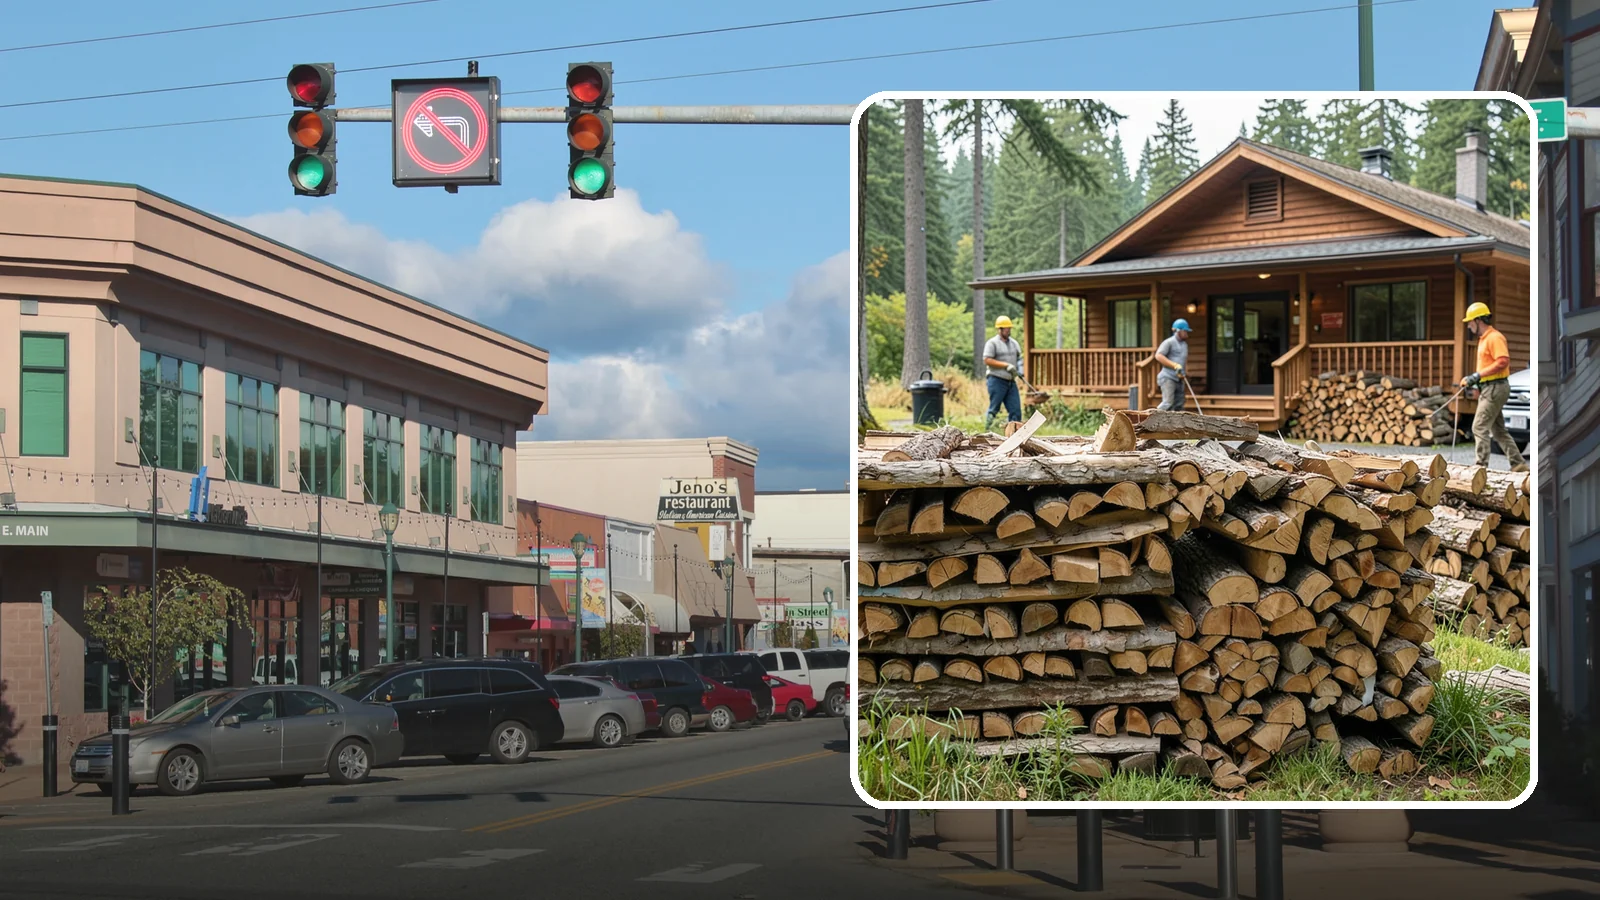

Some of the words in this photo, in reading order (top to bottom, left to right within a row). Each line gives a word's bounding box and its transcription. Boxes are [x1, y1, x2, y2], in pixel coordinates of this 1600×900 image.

[670, 480, 727, 494] Jeno's
[665, 496, 731, 509] restaurant
[659, 510, 681, 519] Italian
[686, 510, 714, 519] American
[715, 510, 737, 519] Cuisine
[2, 525, 13, 536] E.
[15, 525, 49, 536] MAIN
[797, 607, 828, 617] Street
